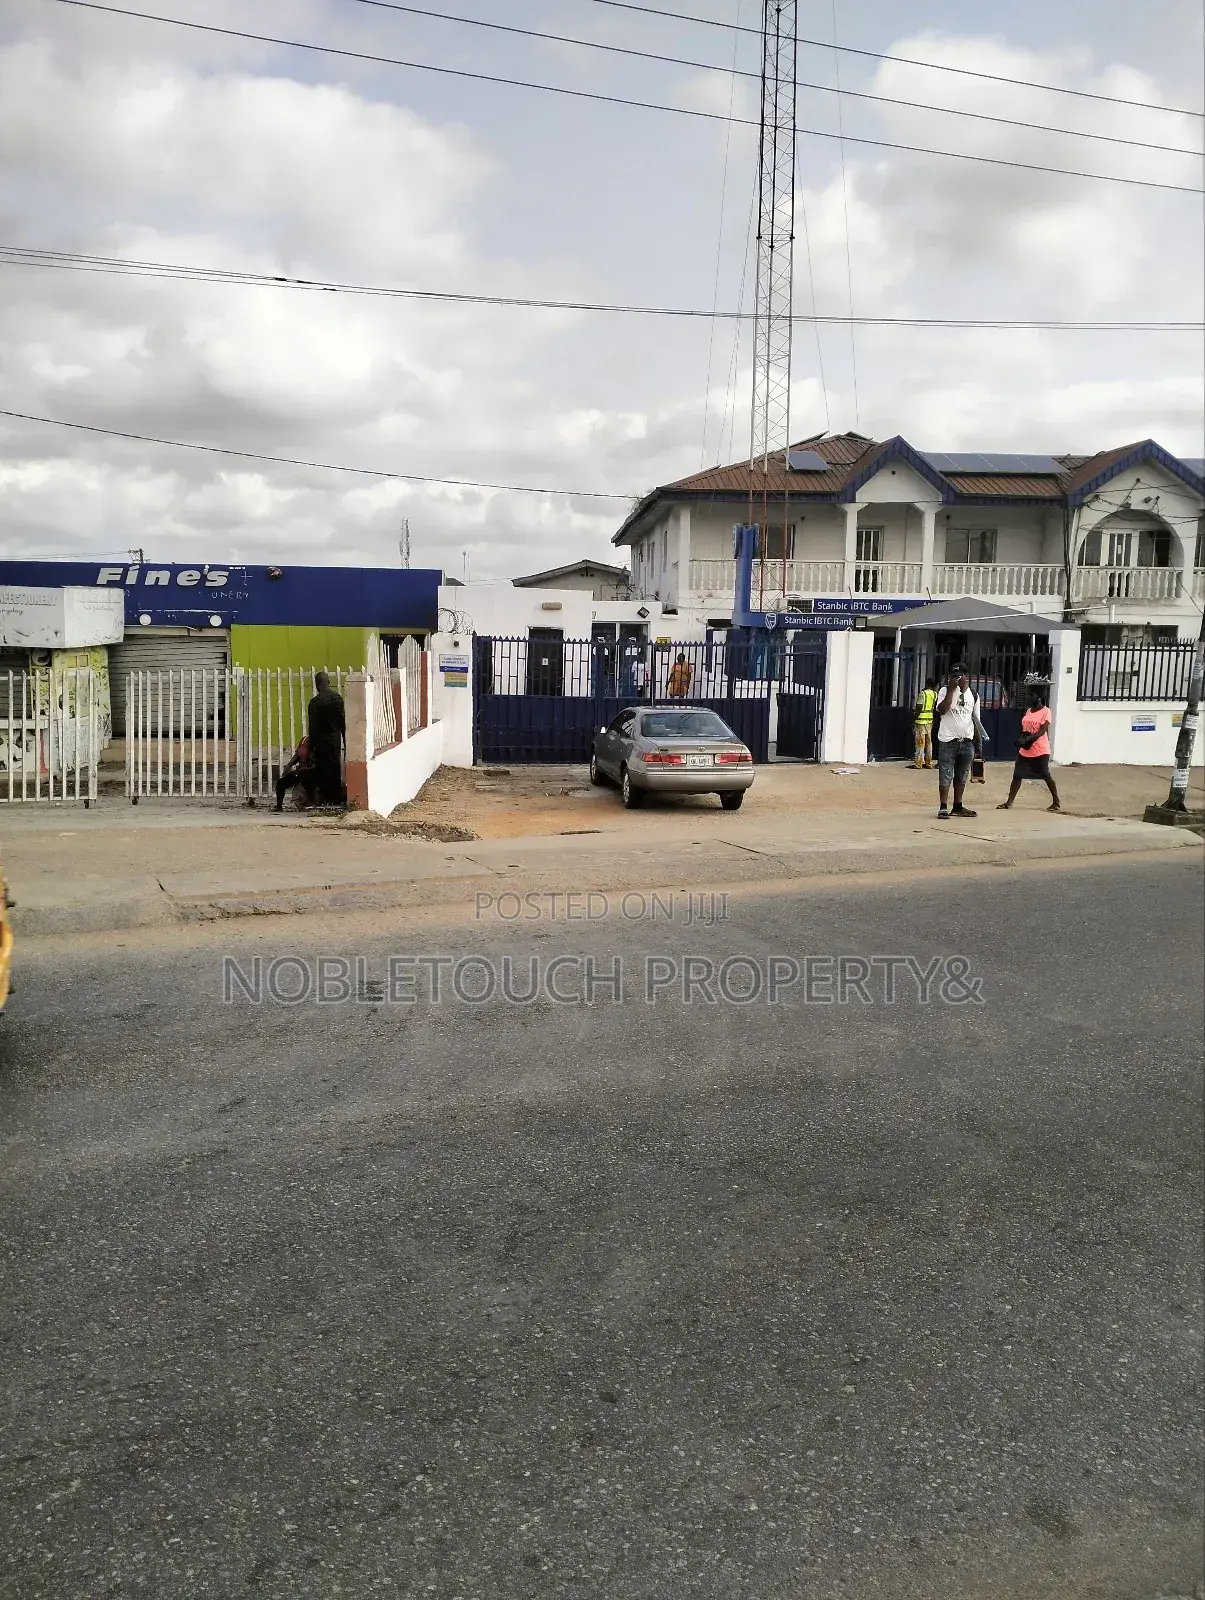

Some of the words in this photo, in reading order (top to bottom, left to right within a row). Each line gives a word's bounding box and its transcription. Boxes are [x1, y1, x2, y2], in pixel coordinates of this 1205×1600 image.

[96, 564, 229, 587] Fine's
[817, 601, 848, 611] Stanbic
[872, 602, 893, 613] Bank
[784, 616, 814, 626] Stanbic
[814, 616, 833, 626] IBTC
[833, 616, 854, 627] Bank
